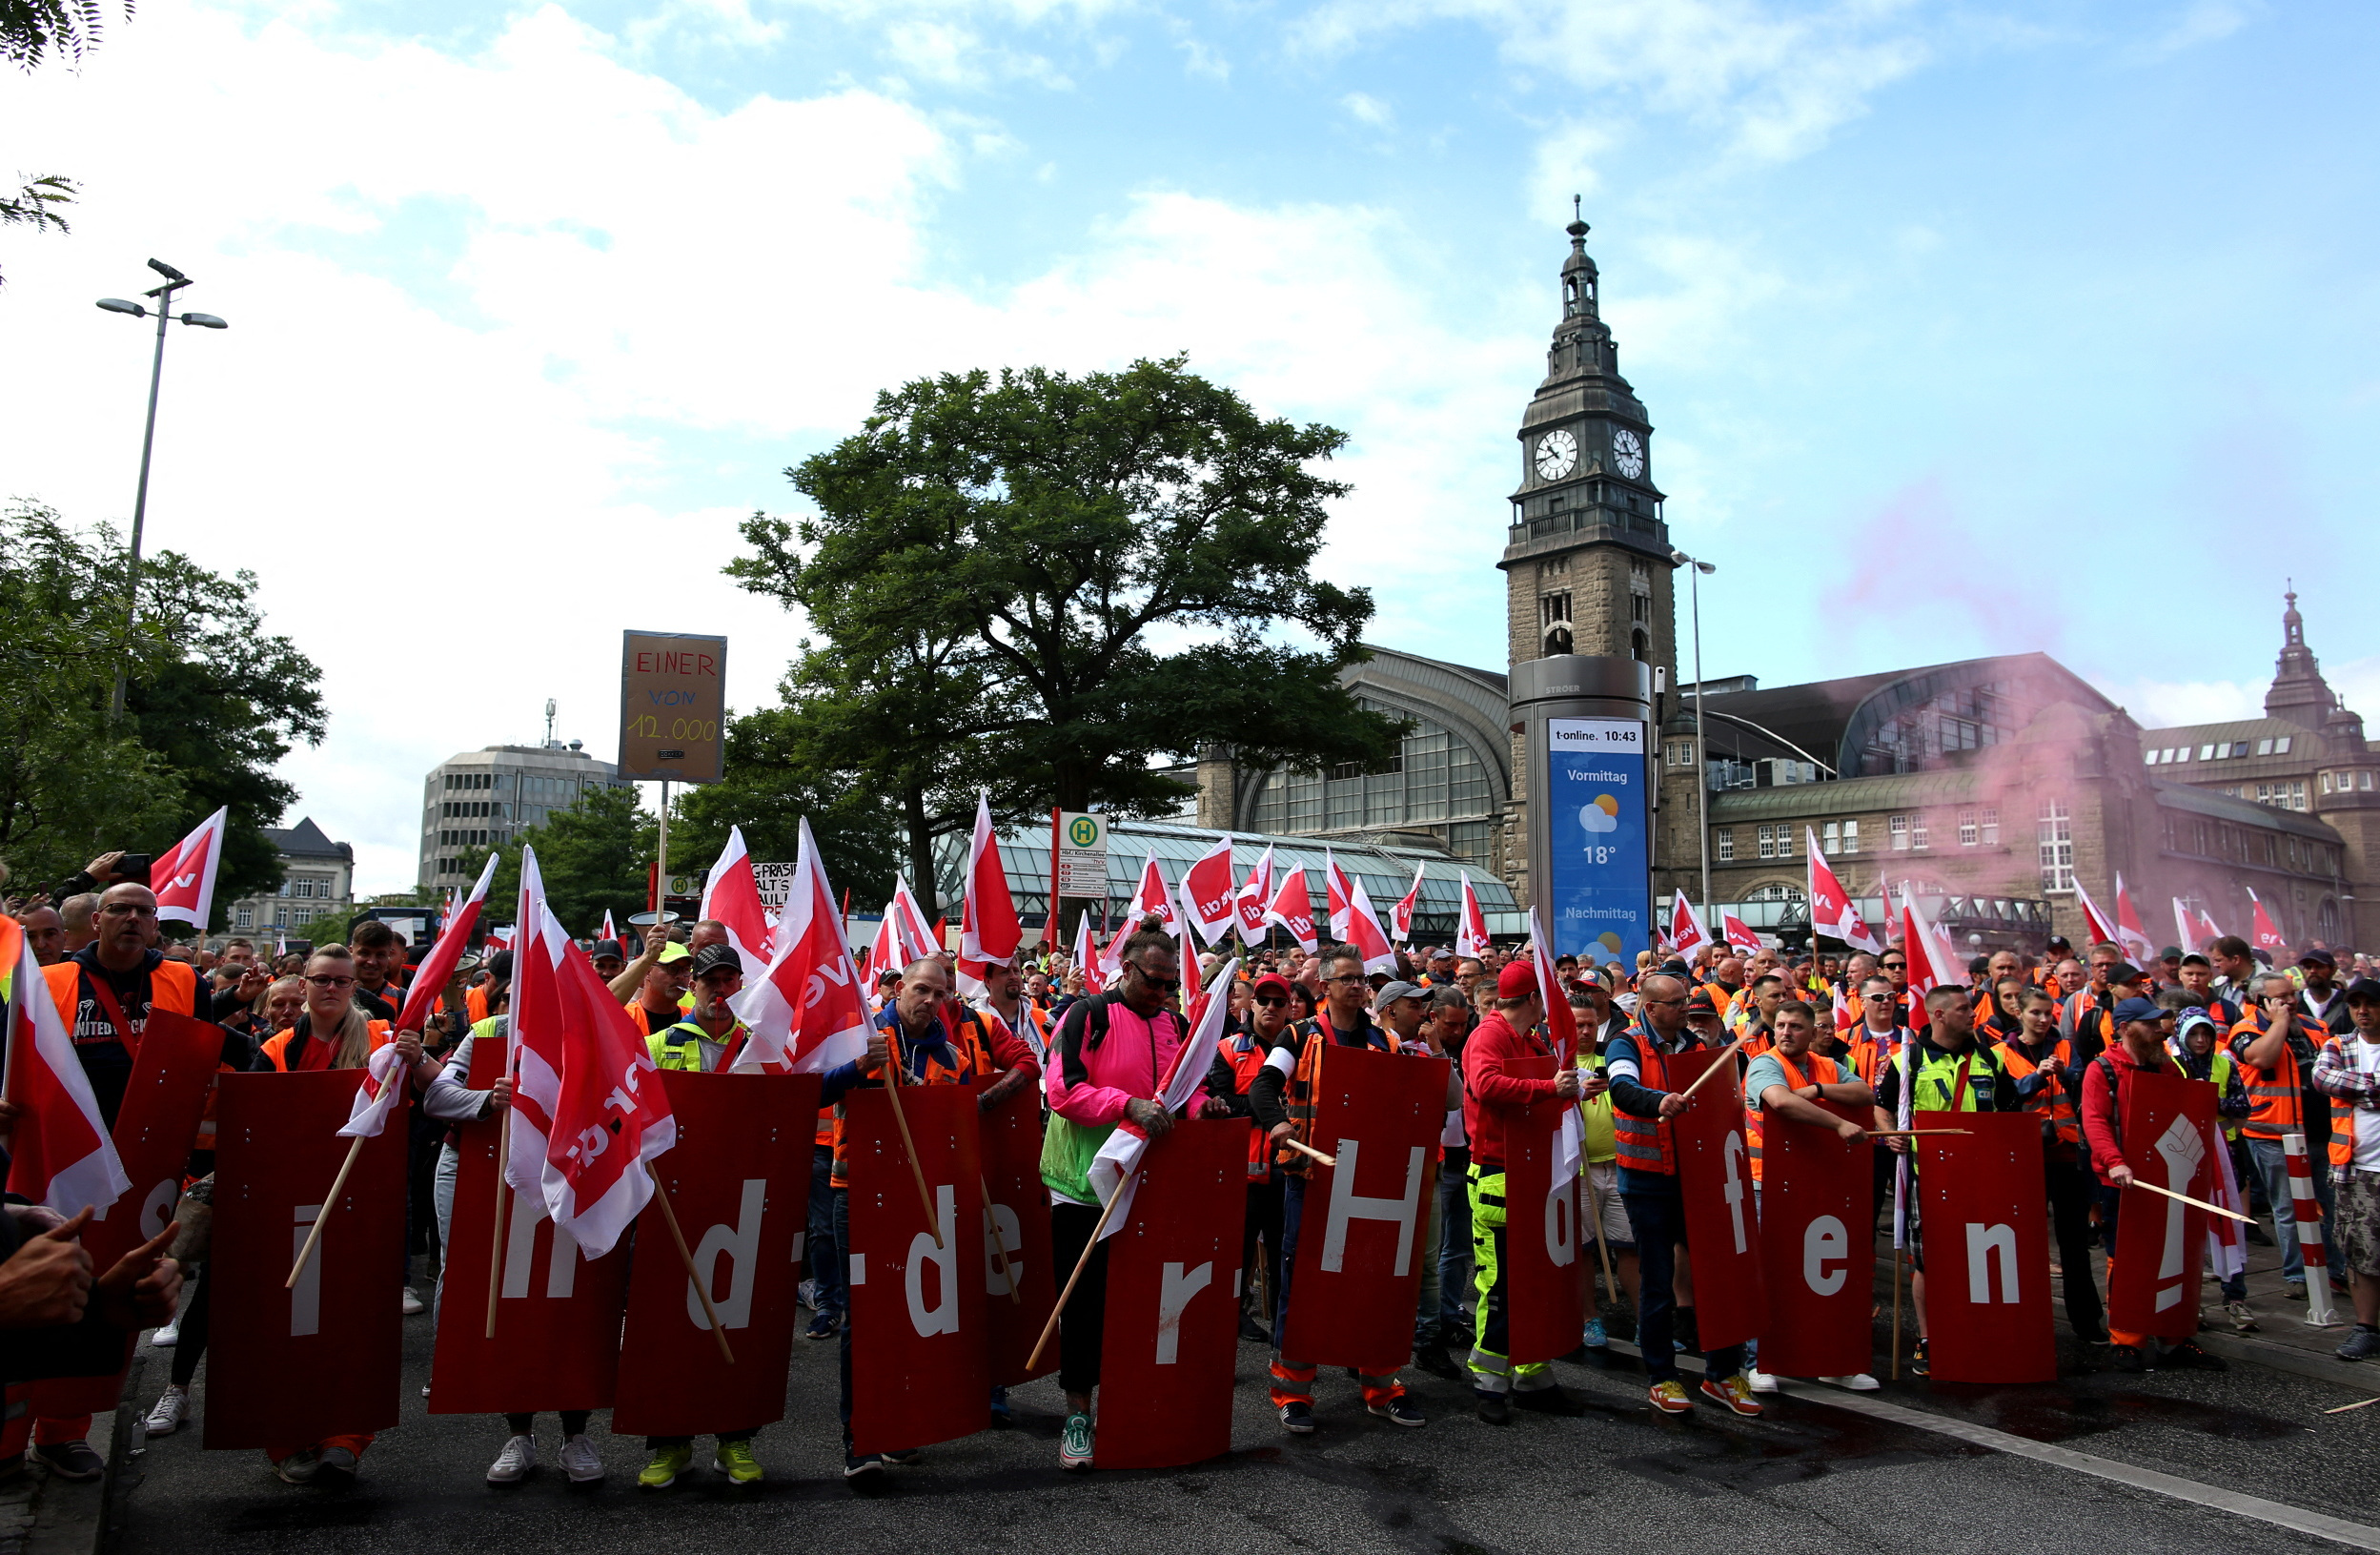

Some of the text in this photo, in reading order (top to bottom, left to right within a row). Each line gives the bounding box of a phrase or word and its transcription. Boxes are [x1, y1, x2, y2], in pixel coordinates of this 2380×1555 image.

[637, 650, 717, 676] EINER
[648, 690, 696, 706] VON
[627, 714, 717, 741] 12.000
[1556, 730, 1637, 742] t-online. 10:43
[1567, 769, 1628, 785] Vormittag
[1583, 847, 1616, 865] 18°
[1565, 907, 1637, 922] Nachmittag
